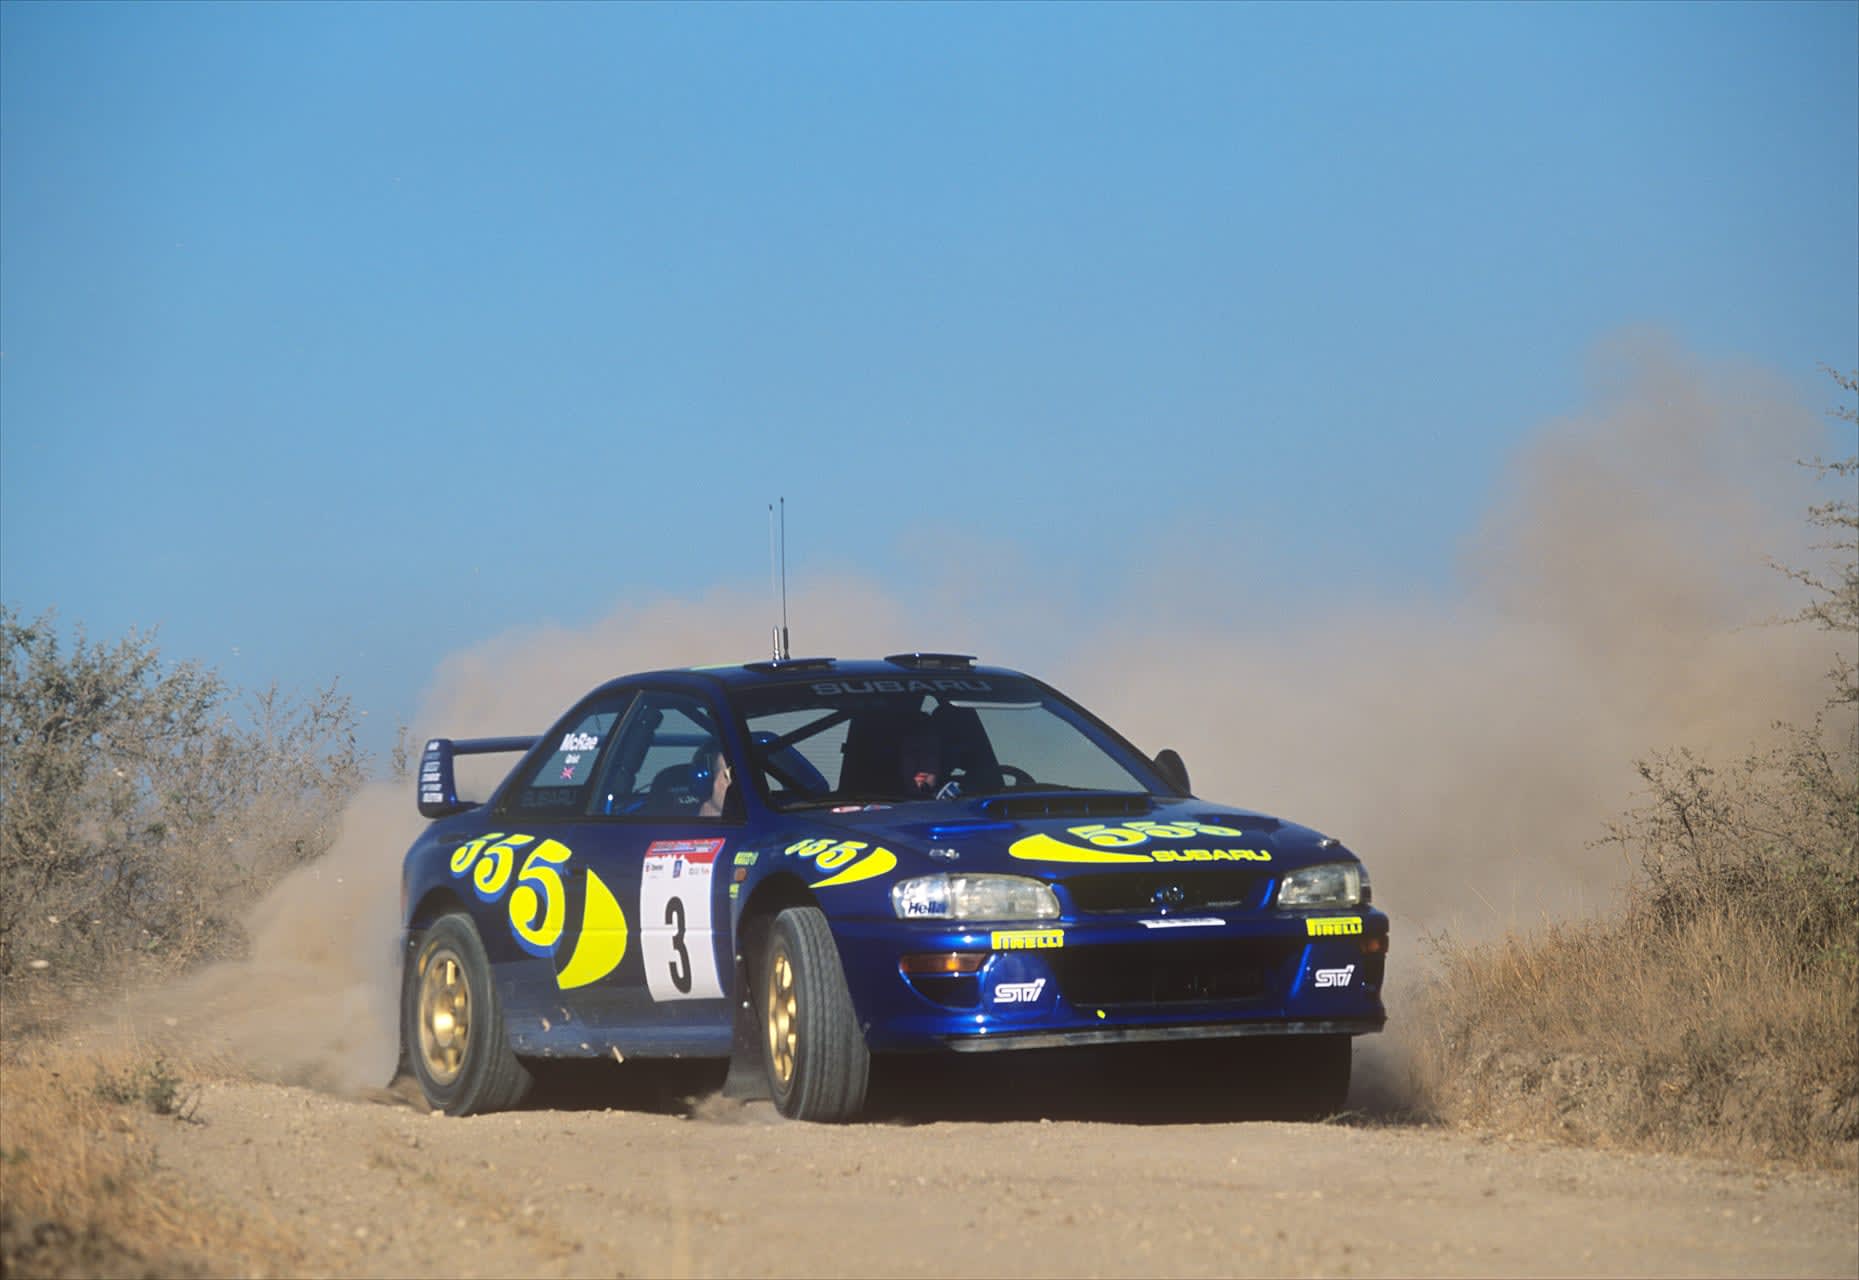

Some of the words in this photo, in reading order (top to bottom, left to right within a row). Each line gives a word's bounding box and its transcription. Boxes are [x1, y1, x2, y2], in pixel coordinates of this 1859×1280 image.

[811, 679, 992, 695] SUBARU
[560, 733, 598, 751] McRae
[1067, 821, 1242, 847] 555
[785, 839, 869, 869] 555
[1151, 849, 1272, 862] SUBARU
[450, 833, 572, 947] 555
[1306, 916, 1362, 936] PIRELLI
[665, 896, 692, 994] 3
[991, 929, 1064, 950] PIRELLI
